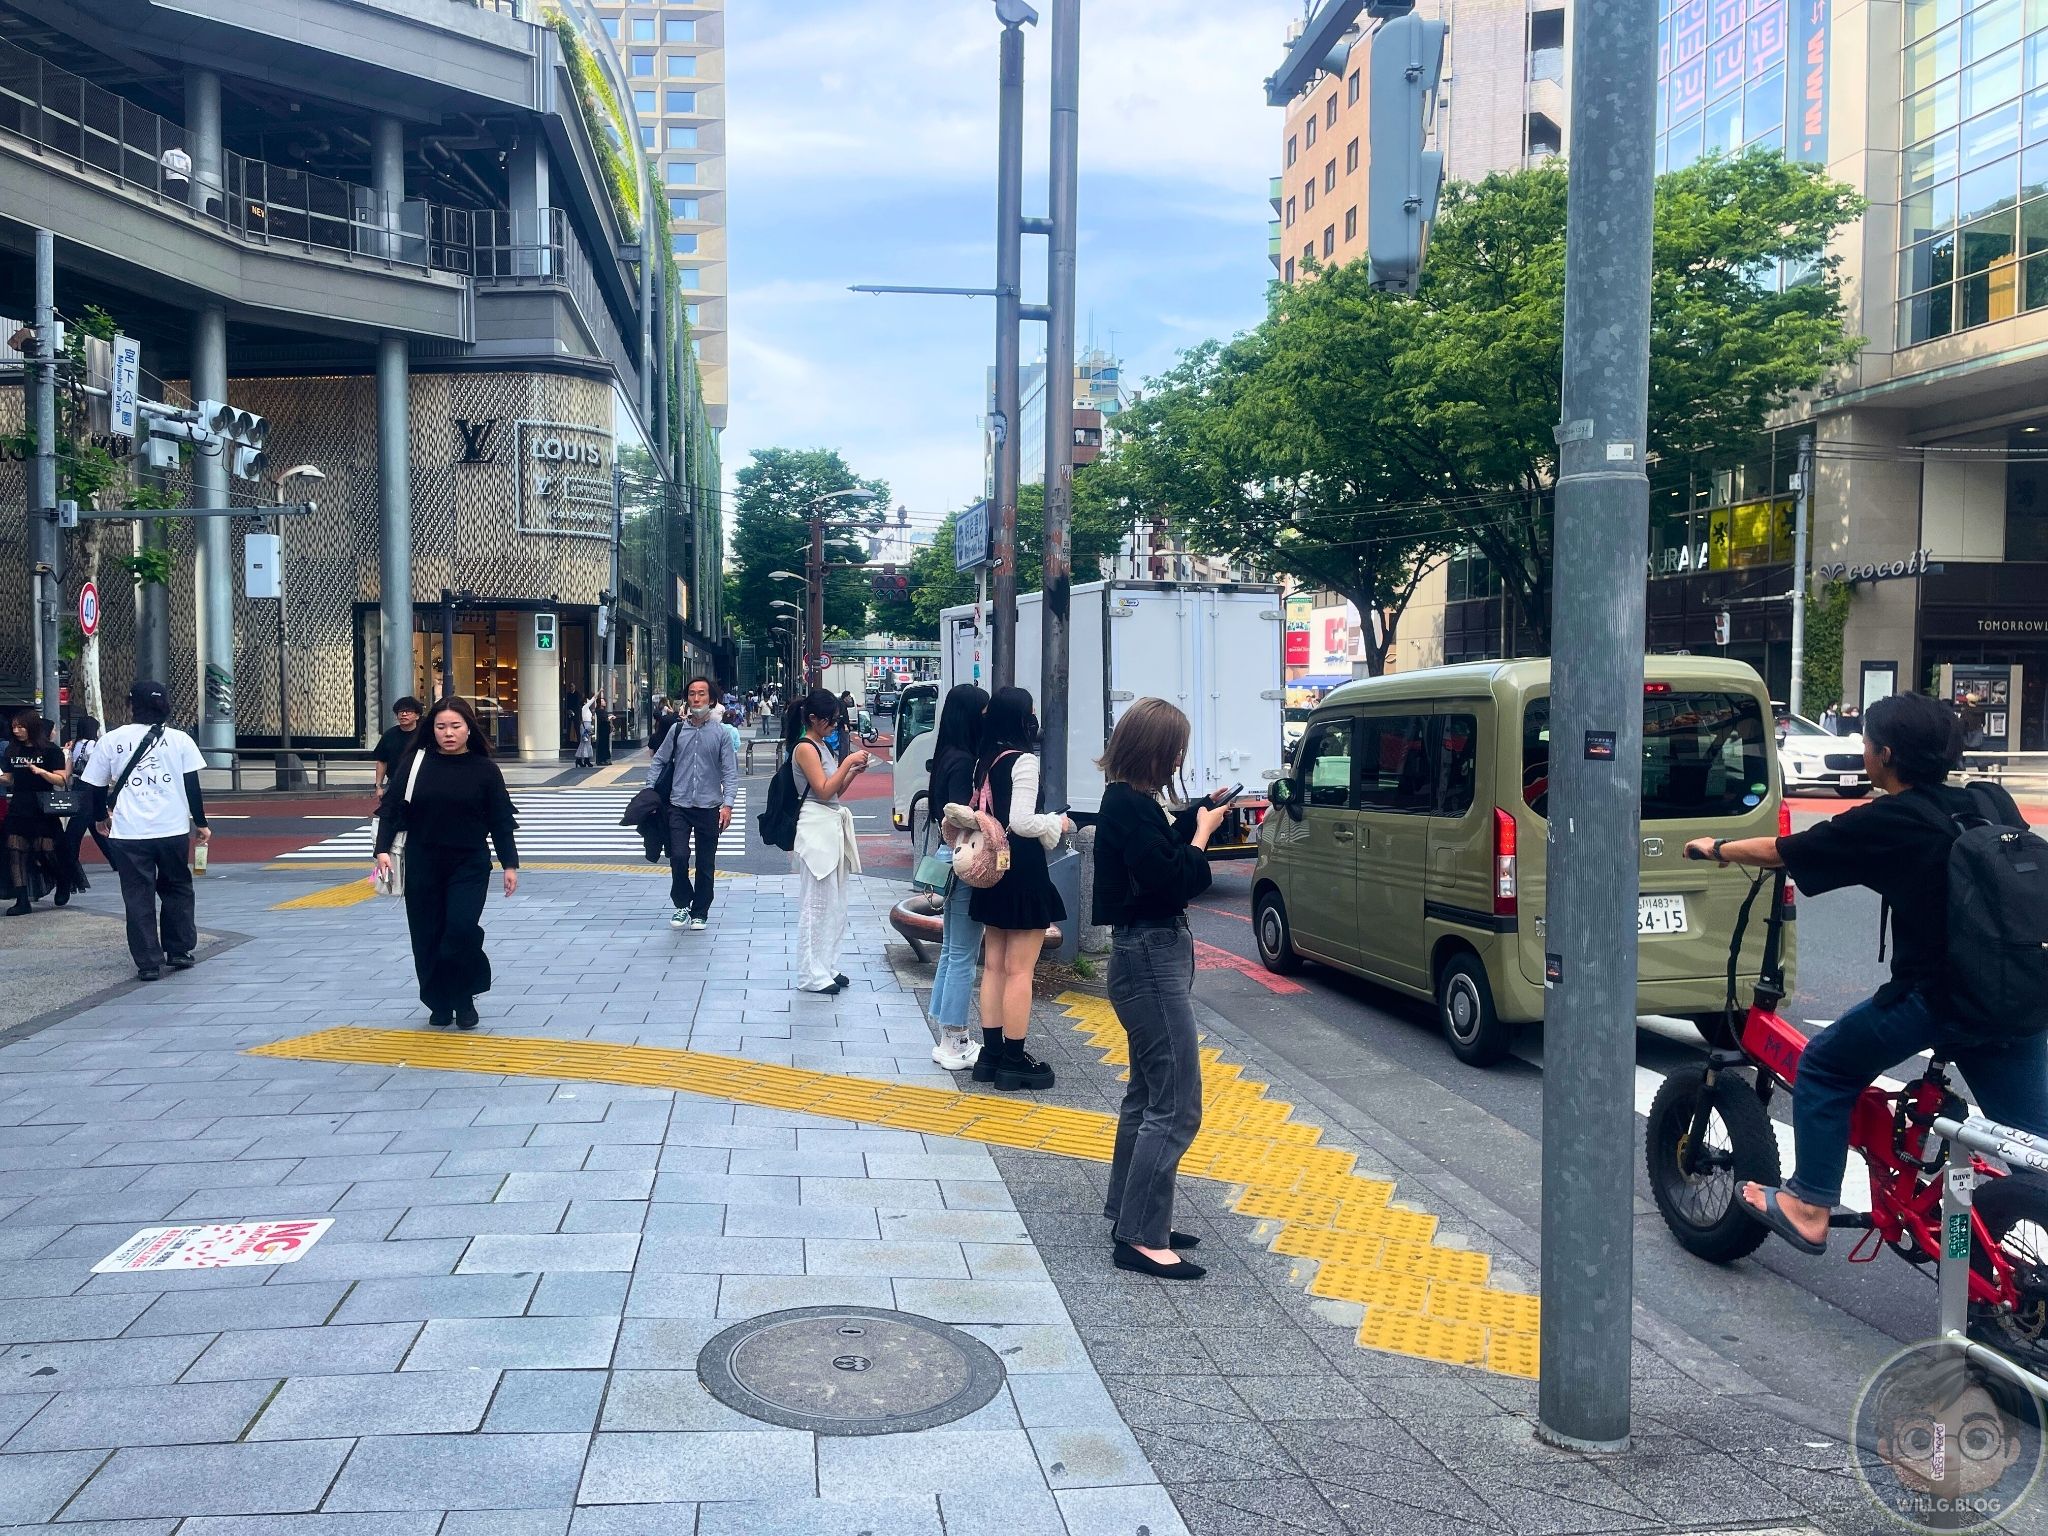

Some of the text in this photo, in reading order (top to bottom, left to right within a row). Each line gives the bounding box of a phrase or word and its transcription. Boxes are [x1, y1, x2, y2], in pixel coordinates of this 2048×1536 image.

[122, 348, 136, 427] 宮下公園
[115, 395, 123, 413] Park
[530, 437, 601, 464] LOUIS
[84, 598, 95, 620] 40
[116, 737, 169, 754] BIA
[1952, 1173, 1971, 1181] have
[231, 1225, 272, 1255] SMOKING
